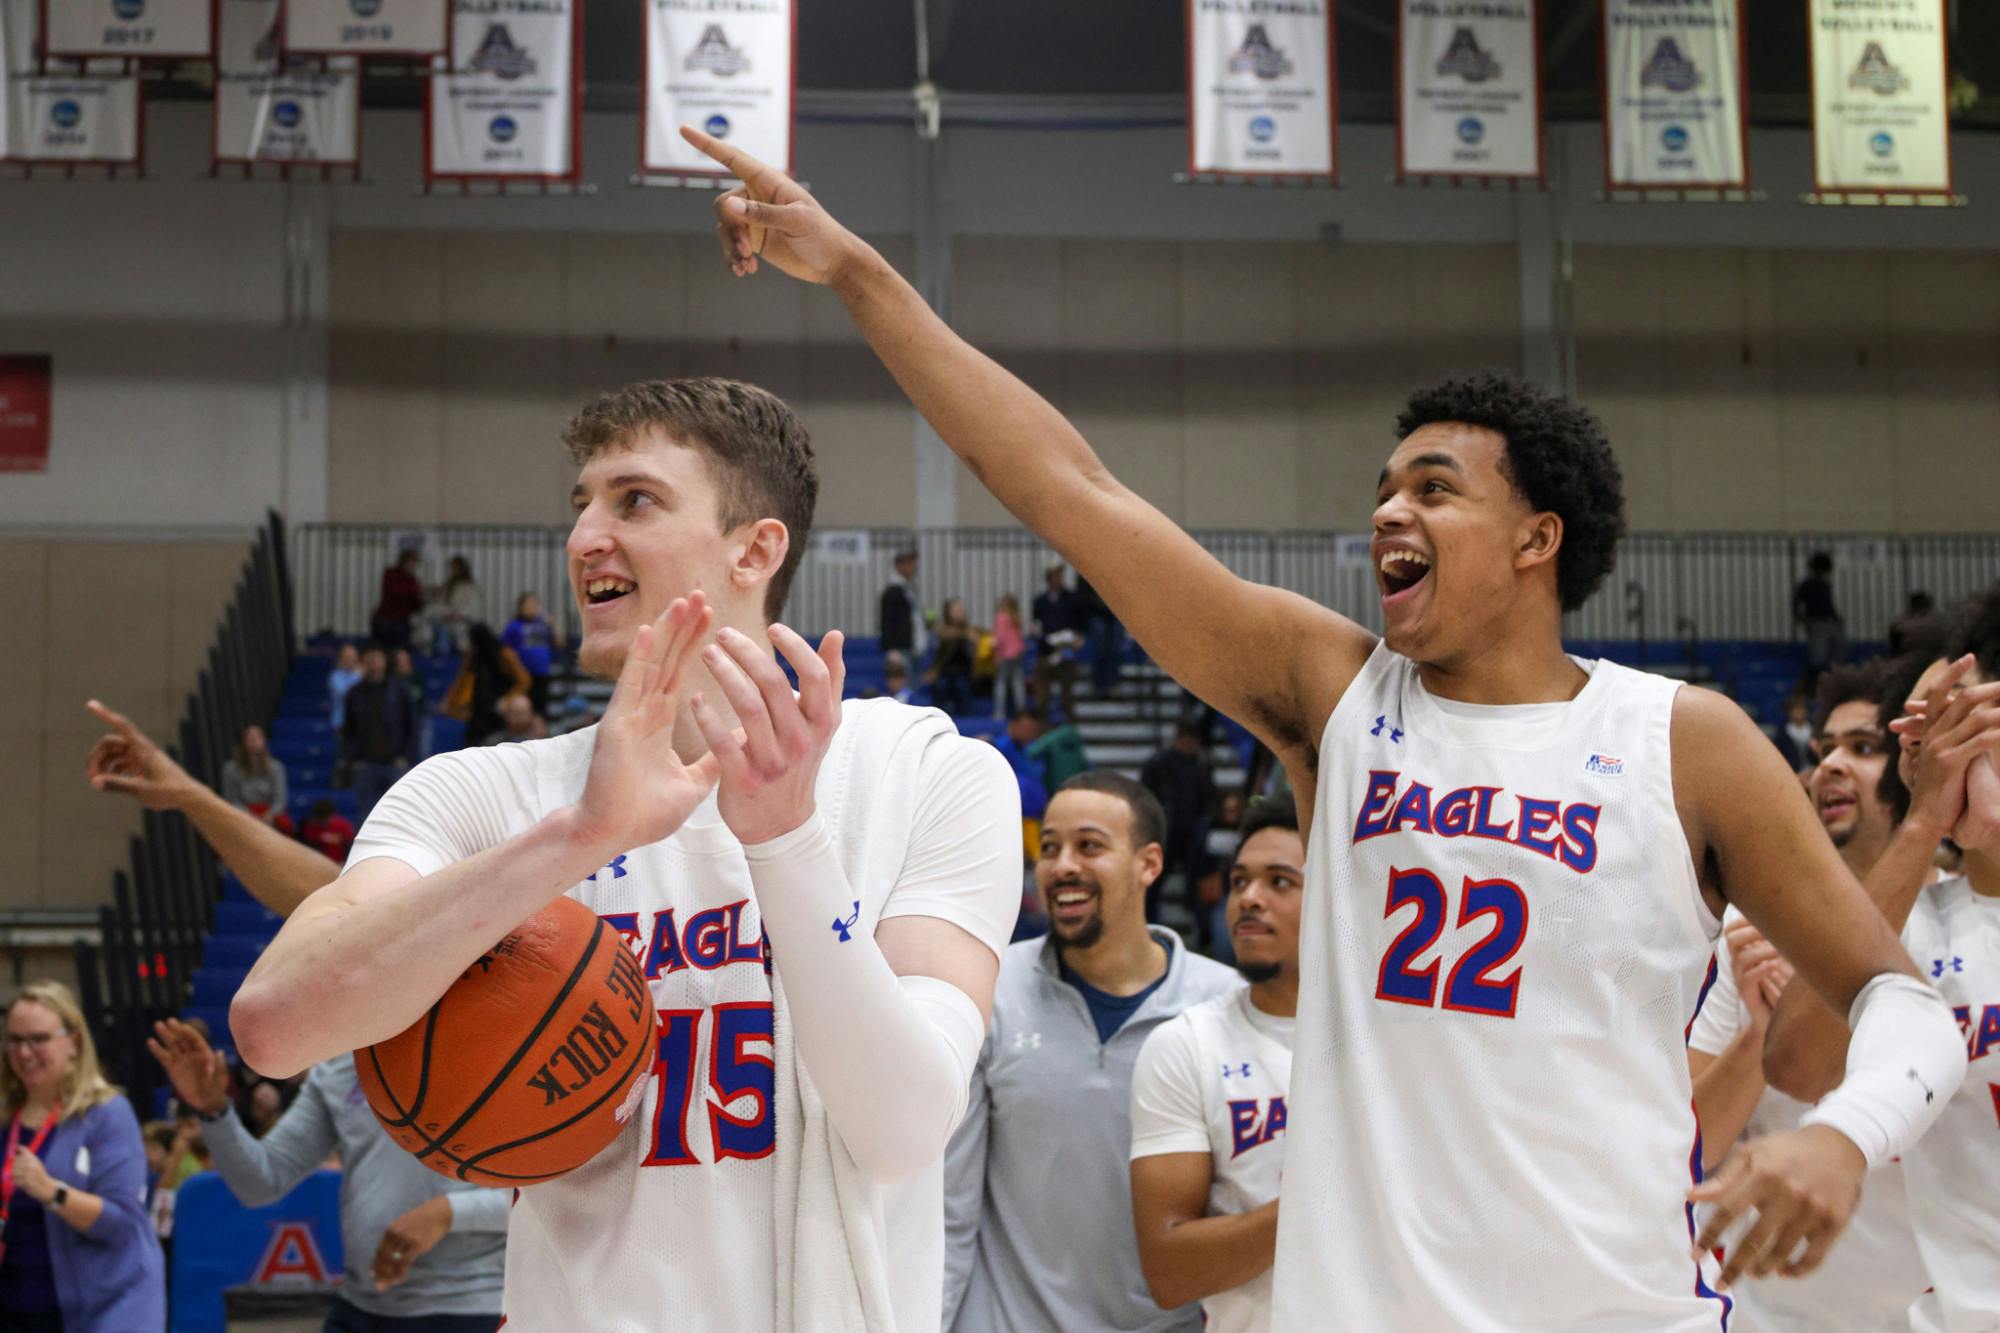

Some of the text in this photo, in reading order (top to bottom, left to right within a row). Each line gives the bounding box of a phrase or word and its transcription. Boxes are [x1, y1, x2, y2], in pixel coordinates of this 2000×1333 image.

[1353, 770, 1602, 874] EAGLES
[1375, 865, 1529, 1018] 22
[527, 1000, 629, 1106] ROCK
[641, 1001, 777, 1167] 15
[251, 1222, 329, 1284] A
